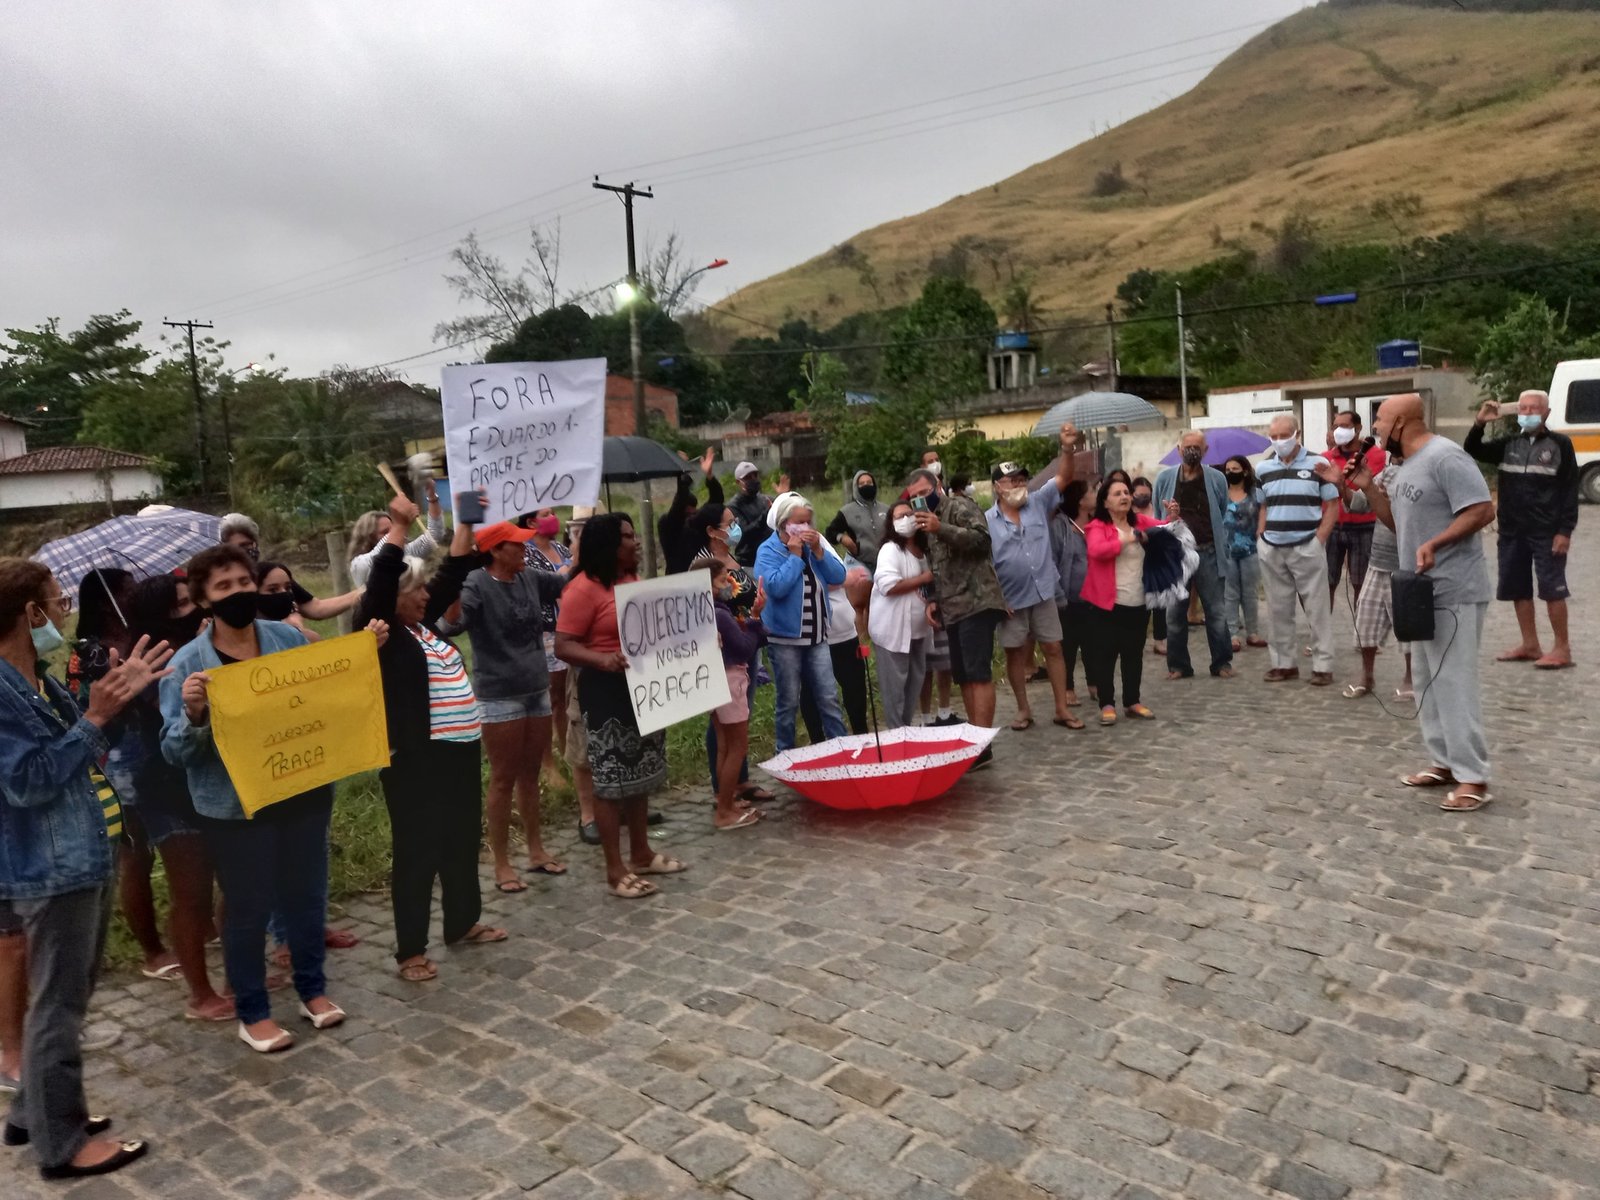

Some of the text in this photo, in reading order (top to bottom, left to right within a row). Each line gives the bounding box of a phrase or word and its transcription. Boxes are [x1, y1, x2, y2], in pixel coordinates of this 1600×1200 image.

[469, 373, 555, 420] FORA
[468, 422, 557, 463] EDUARDO
[534, 447, 557, 466] DO
[502, 473, 575, 517] POVO
[621, 590, 715, 657] QUEREMOS
[656, 640, 699, 670] NOSSA
[249, 658, 352, 694] Queremos
[633, 664, 710, 717] PRAÇA
[263, 719, 326, 746] nossa
